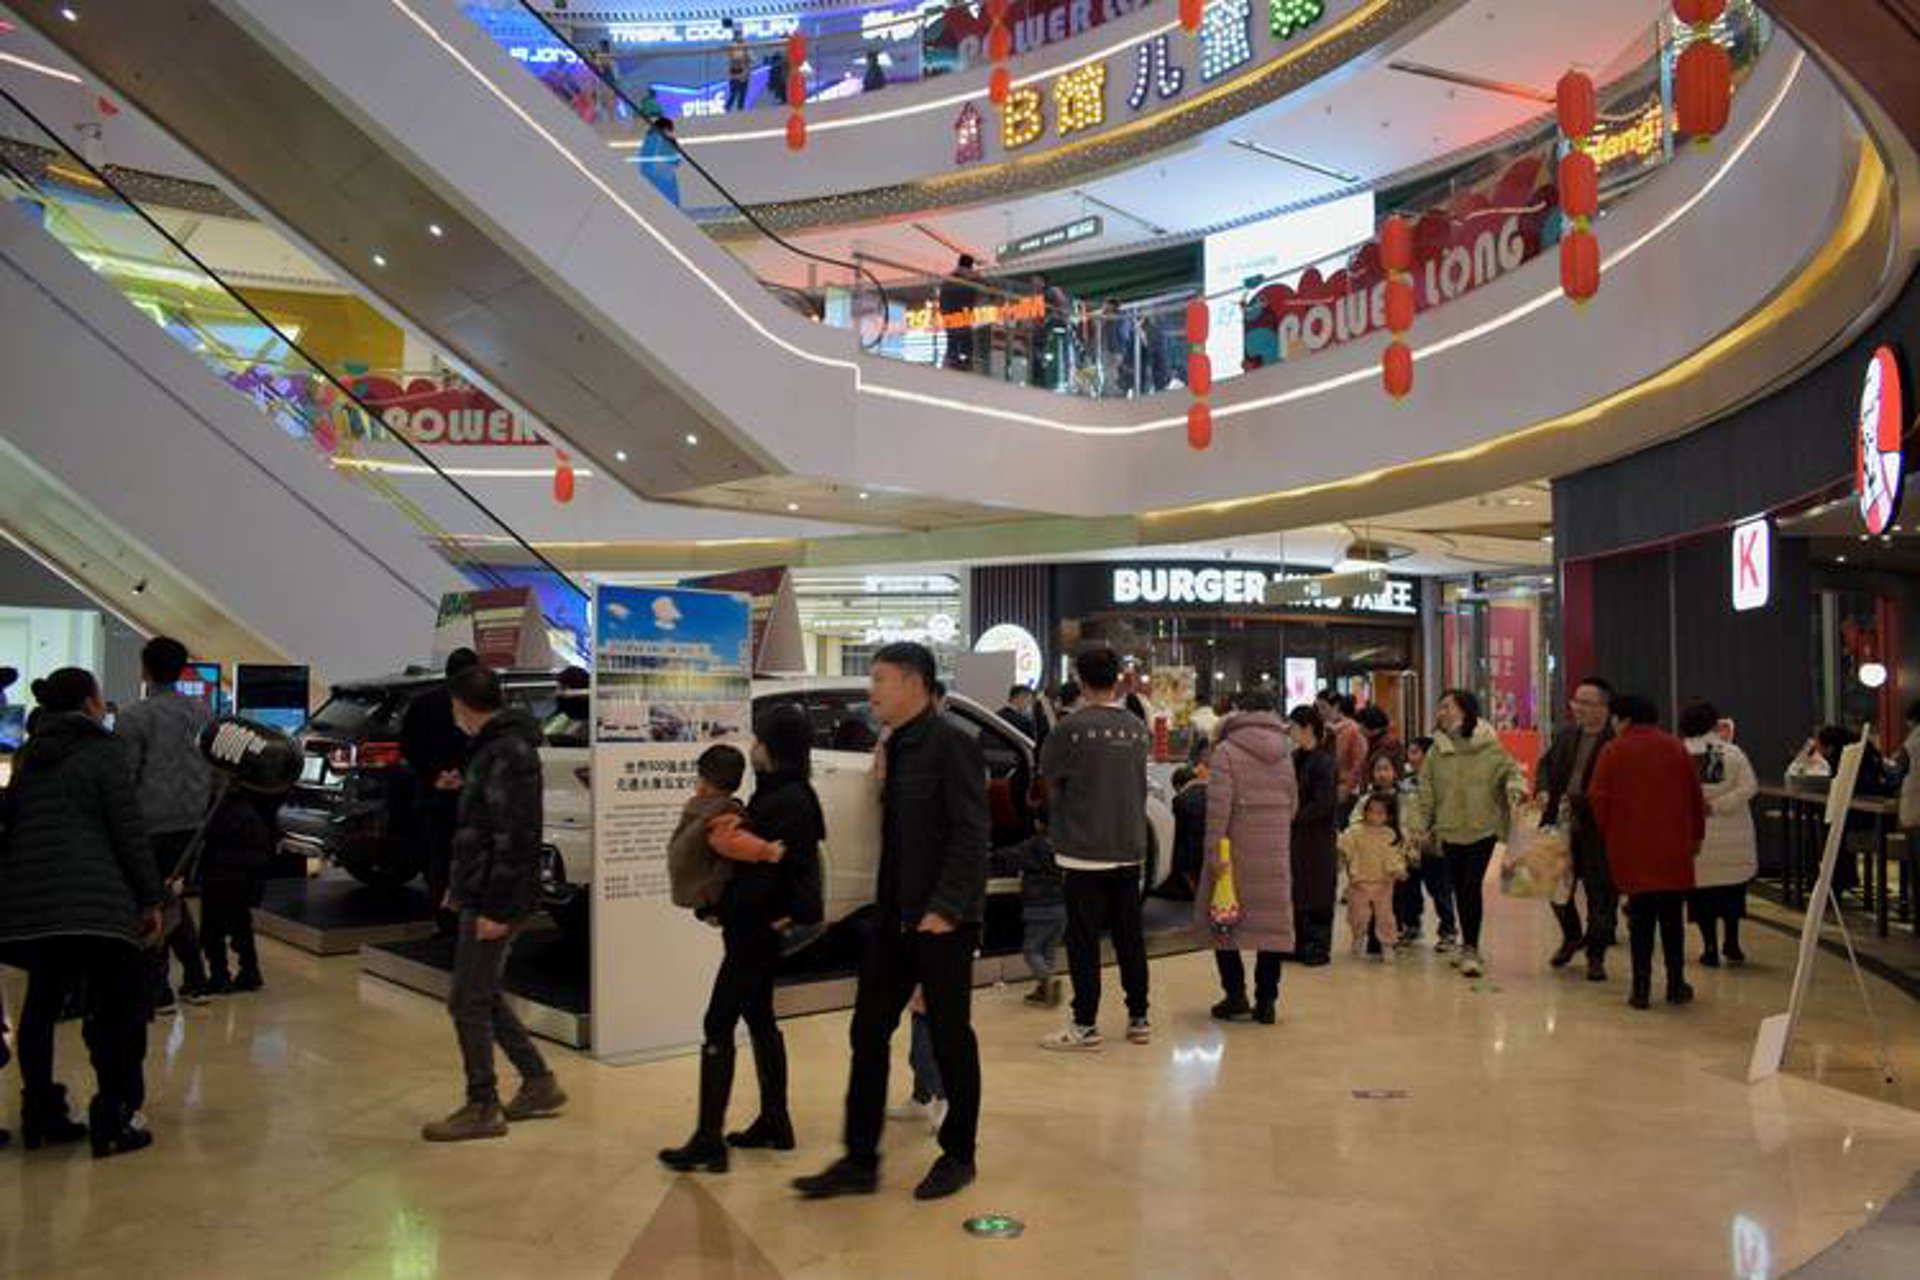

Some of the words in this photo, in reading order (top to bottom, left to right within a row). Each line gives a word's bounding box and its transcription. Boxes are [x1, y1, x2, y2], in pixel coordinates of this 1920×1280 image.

[1425, 216, 1525, 305] LONG
[1112, 568, 1267, 605] BURGER
[1740, 529, 1759, 592] K
